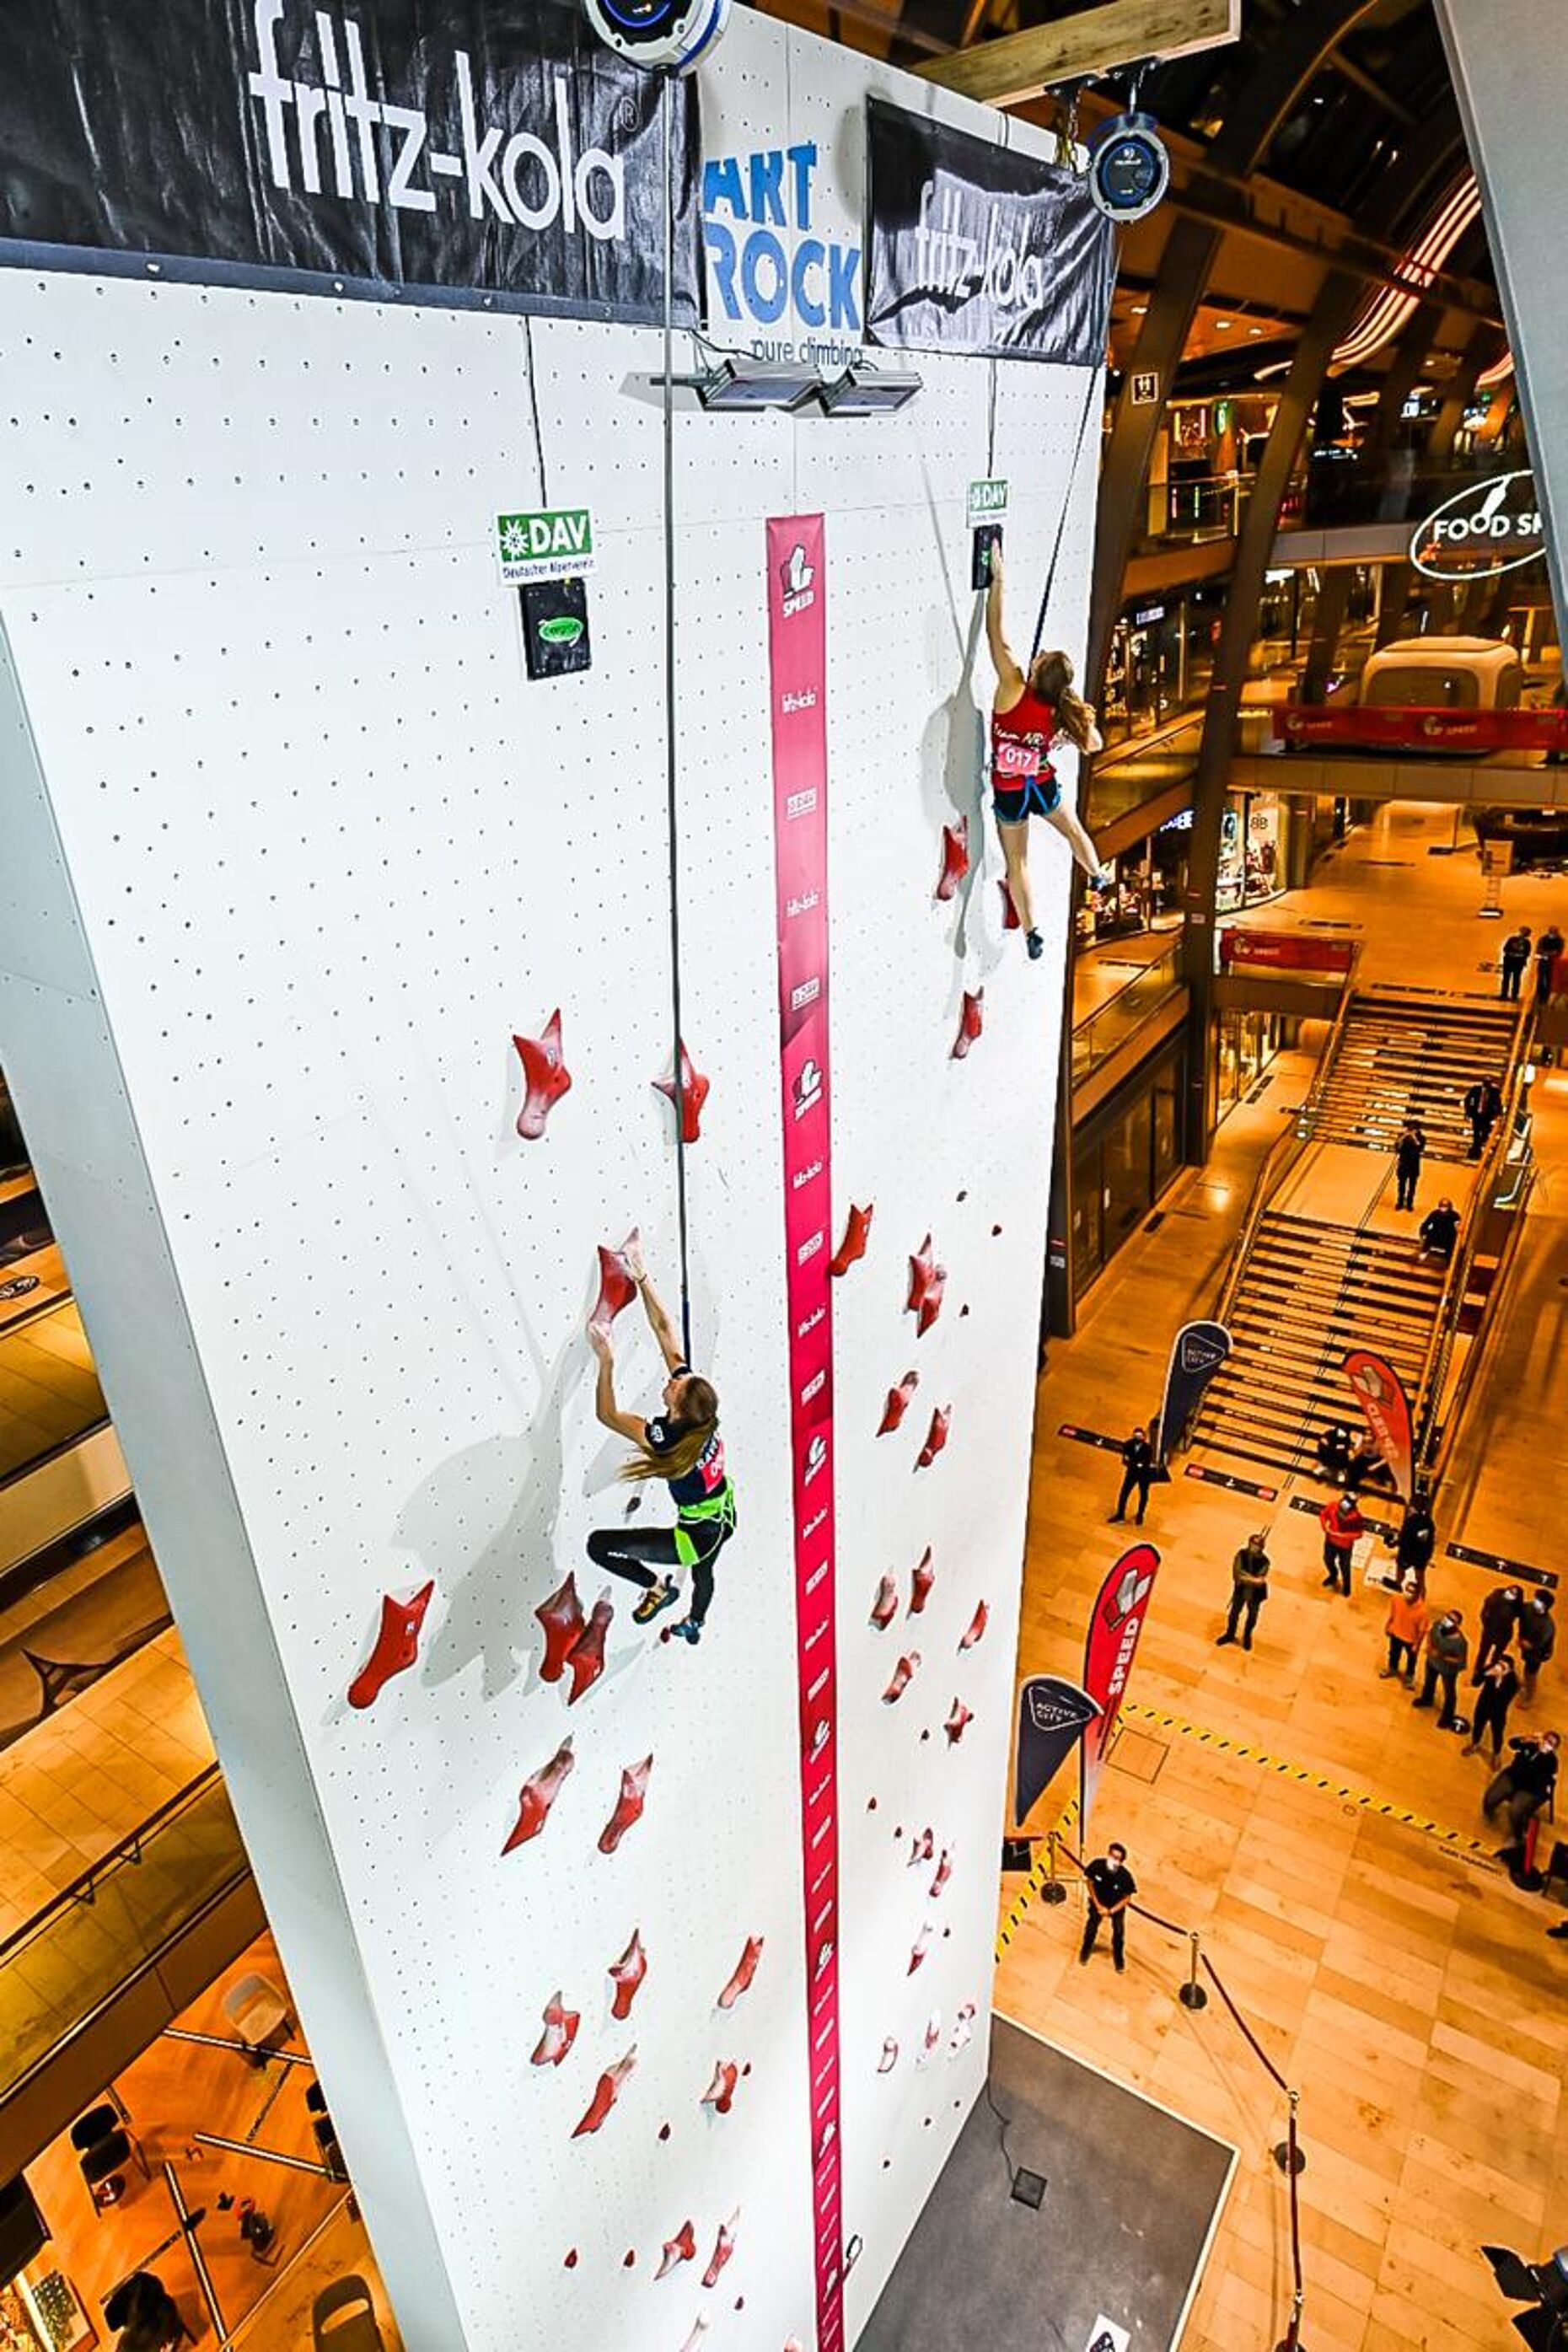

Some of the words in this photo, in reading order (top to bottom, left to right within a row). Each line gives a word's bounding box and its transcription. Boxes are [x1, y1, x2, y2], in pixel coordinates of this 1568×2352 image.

[249, 0, 625, 241] fritz-kola
[704, 221, 862, 330] ROCK
[529, 515, 588, 555] DAV
[1434, 512, 1511, 543] FOOD
[1005, 748, 1032, 768] 017
[1109, 1617, 1138, 1694] SPEED
[1036, 1702, 1078, 1718] ACTIVE
[1036, 1710, 1062, 1722] CITY
